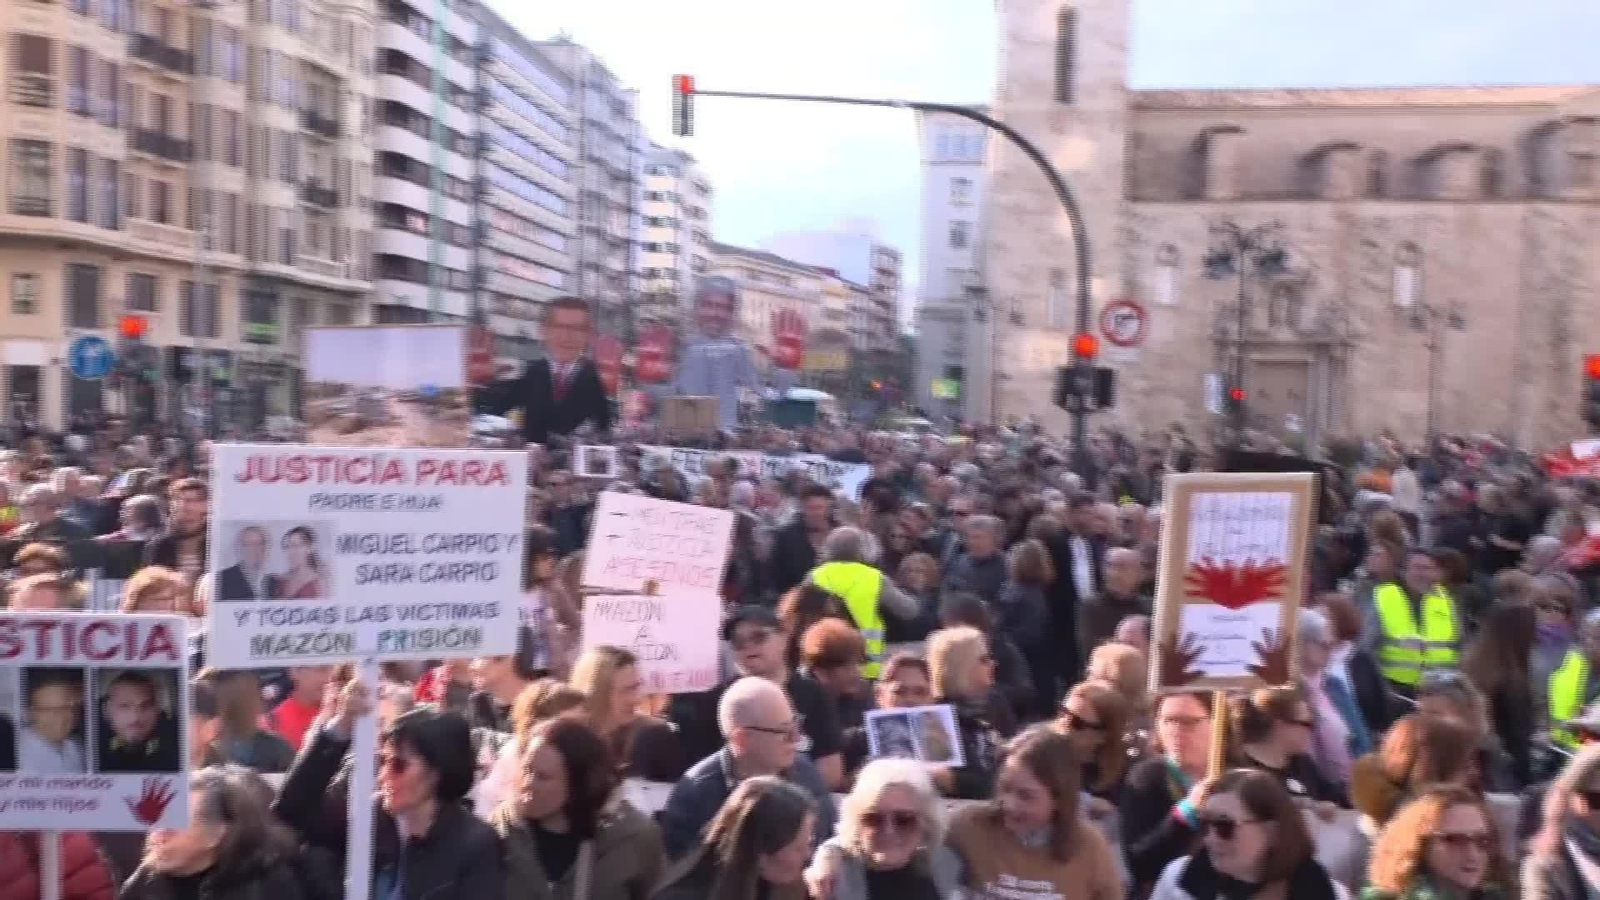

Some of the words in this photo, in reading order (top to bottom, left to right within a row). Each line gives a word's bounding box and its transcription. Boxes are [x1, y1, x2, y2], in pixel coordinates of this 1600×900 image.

[236, 454, 407, 484] JUSTICIA
[416, 459, 508, 487] PARA
[308, 493, 373, 510] PADRE
[378, 493, 393, 509] E
[399, 493, 442, 509] HIJA
[336, 533, 413, 554] MIGUEL
[421, 533, 499, 553] CARPIO
[503, 533, 520, 552] Y
[355, 563, 411, 585] SARA
[418, 562, 497, 583] CARPIO
[234, 609, 251, 627] Y
[257, 606, 339, 626] TODAS
[345, 604, 389, 622] LAS
[397, 601, 500, 620] VICTIMAS
[0, 619, 180, 661] STICIA
[251, 629, 352, 656] MAZÓN
[377, 625, 481, 651] PRISIÓN
[18, 777, 42, 788] mi
[46, 776, 114, 790] marido
[14, 798, 48, 811] mis
[52, 797, 99, 814] hijos
